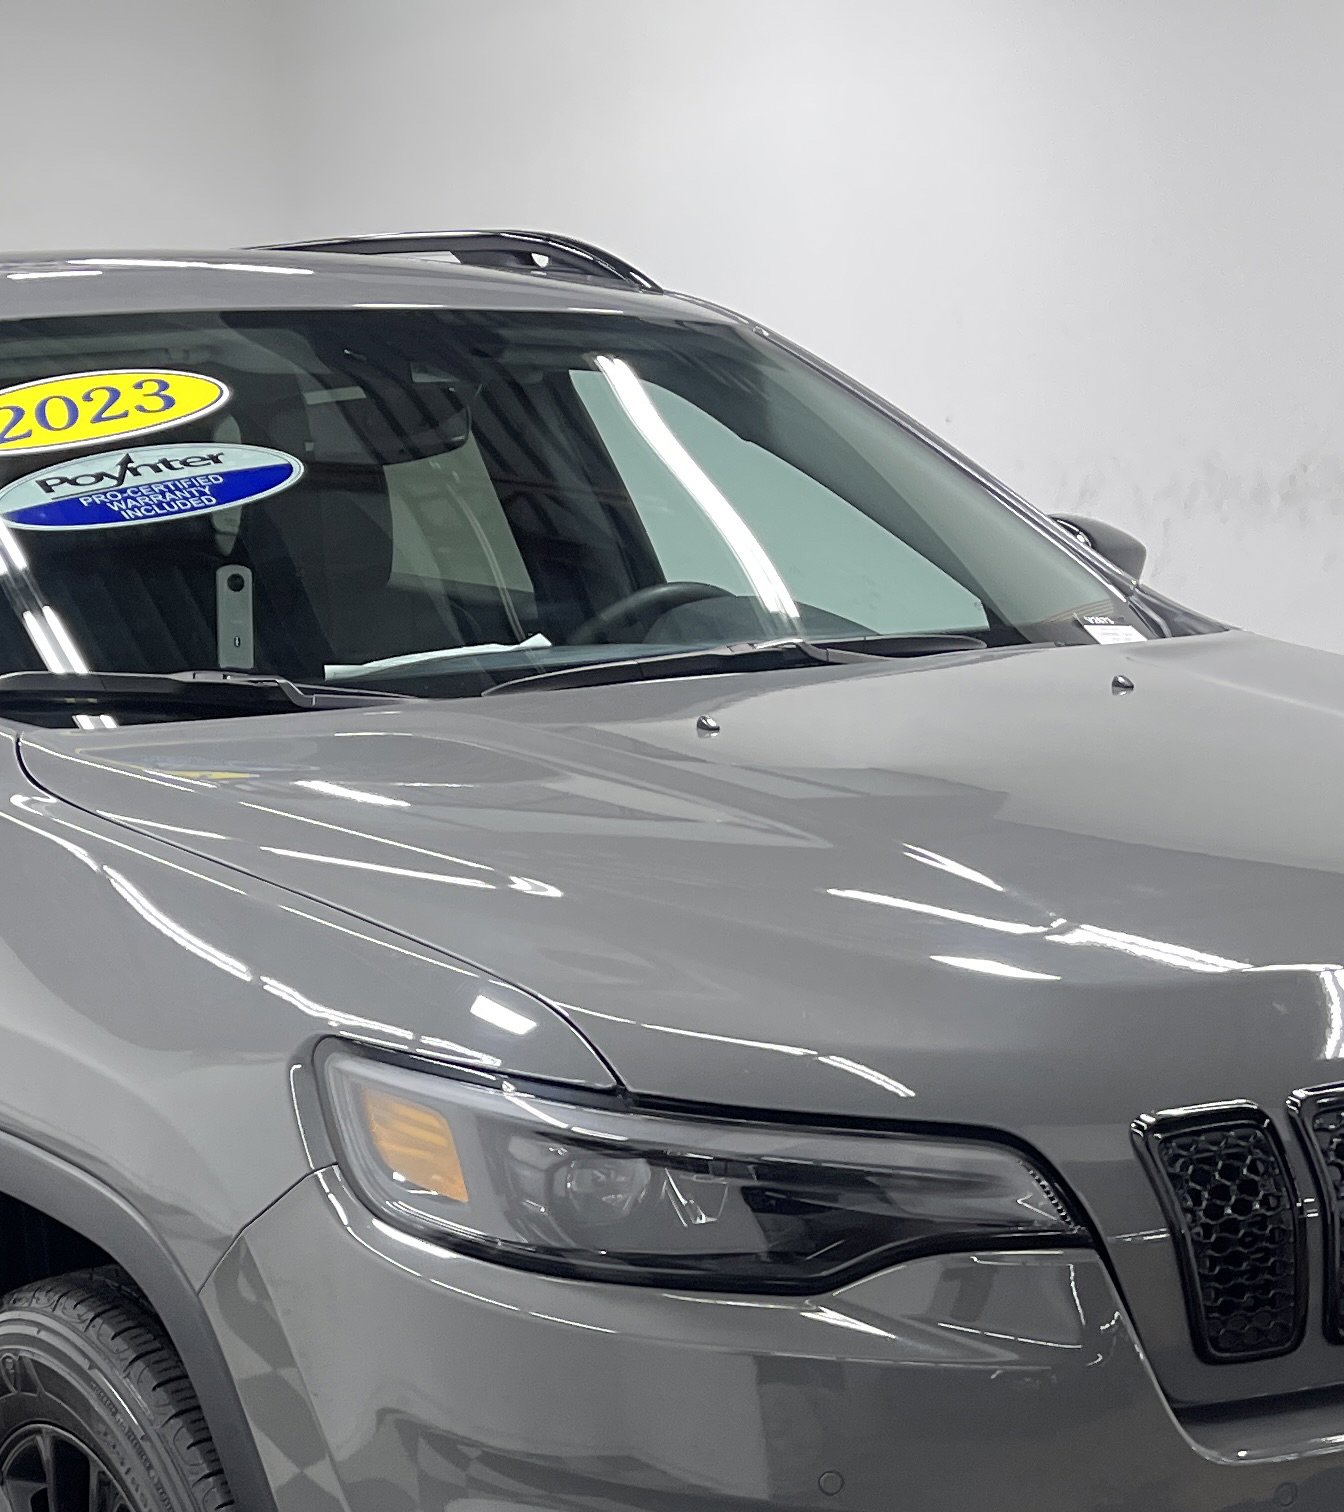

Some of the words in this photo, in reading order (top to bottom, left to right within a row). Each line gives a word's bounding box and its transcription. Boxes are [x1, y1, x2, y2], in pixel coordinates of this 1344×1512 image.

[35, 453, 224, 494] Poynter
[79, 474, 224, 507] PRO-CERTIFIED
[106, 485, 212, 512] WARRANTY
[121, 495, 217, 520] INCLUDED
